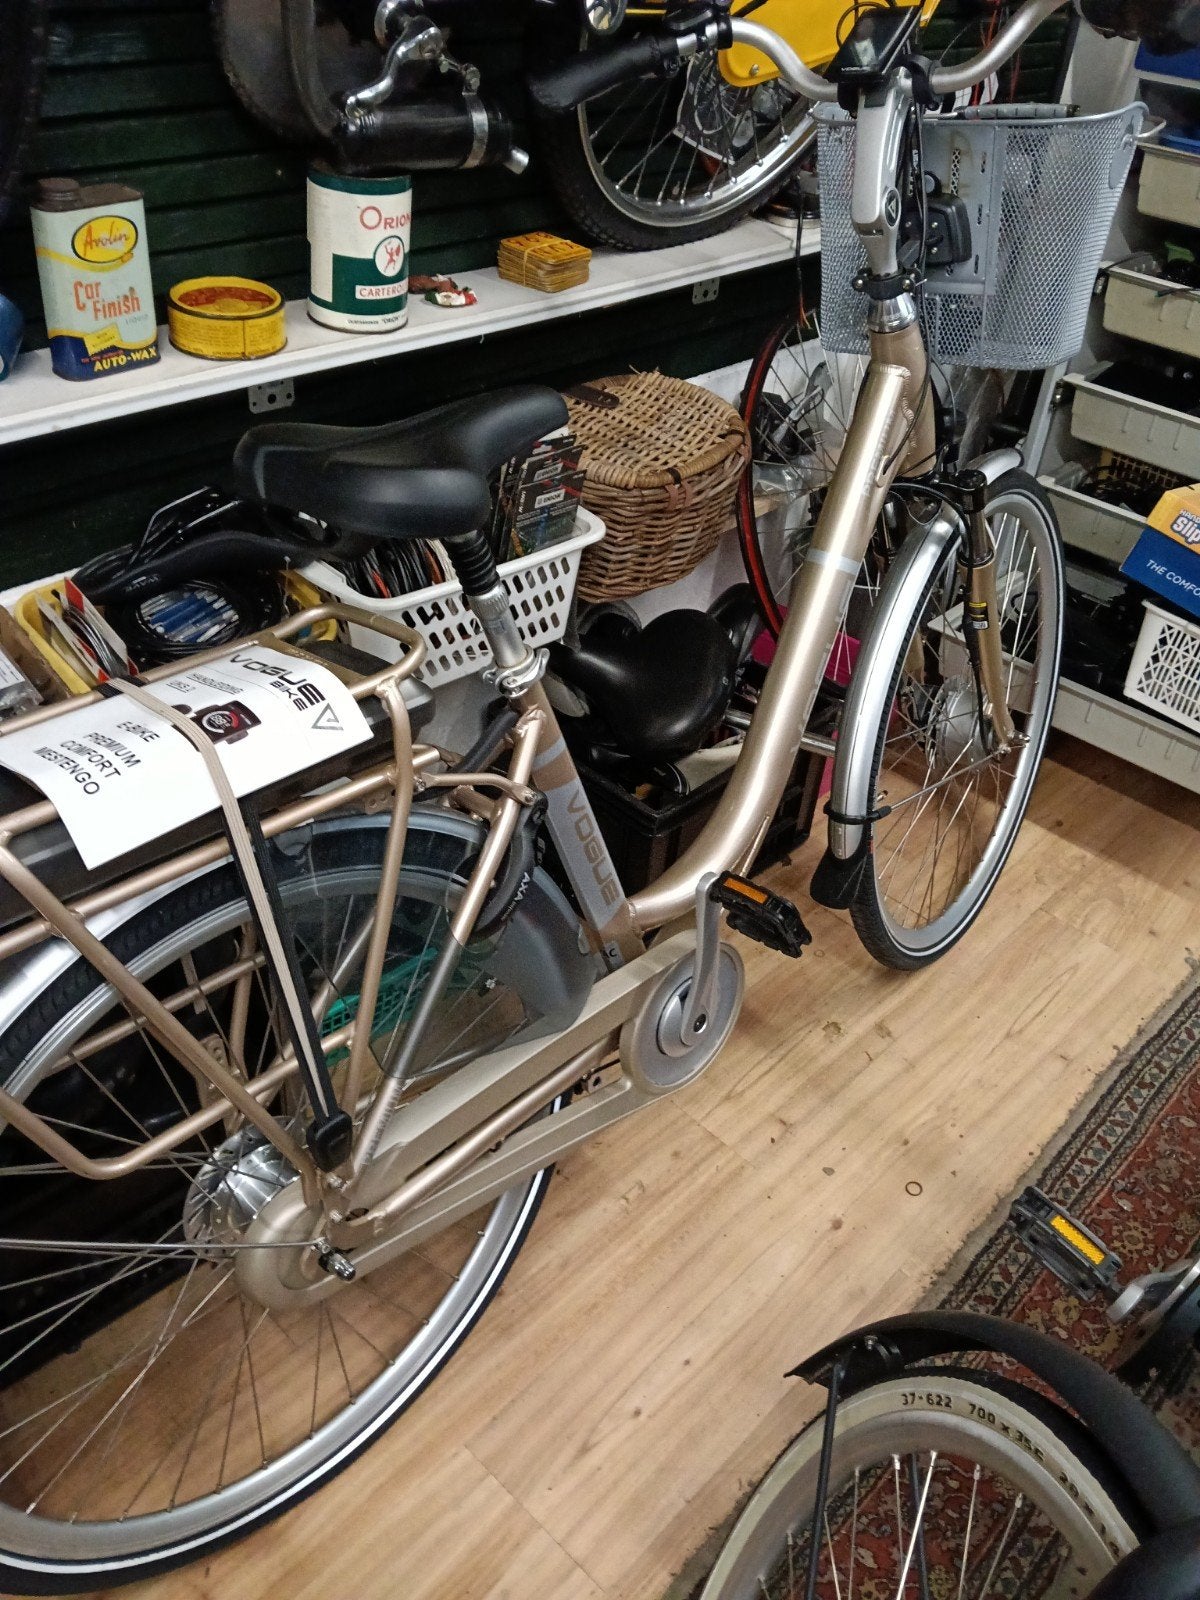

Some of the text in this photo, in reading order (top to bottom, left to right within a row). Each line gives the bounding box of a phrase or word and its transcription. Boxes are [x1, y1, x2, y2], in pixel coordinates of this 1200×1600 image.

[73, 280, 101, 312] Car
[92, 286, 141, 321] Finish
[93, 345, 157, 372] AUTO-WAX
[1146, 559, 1168, 575] THE
[229, 653, 326, 706] VOGUE
[269, 680, 309, 711] BIKE
[59, 740, 122, 778] COMFORT
[82, 732, 142, 768] PREMIUM
[566, 788, 621, 907] VOGUE
[513, 871, 531, 901] AXA
